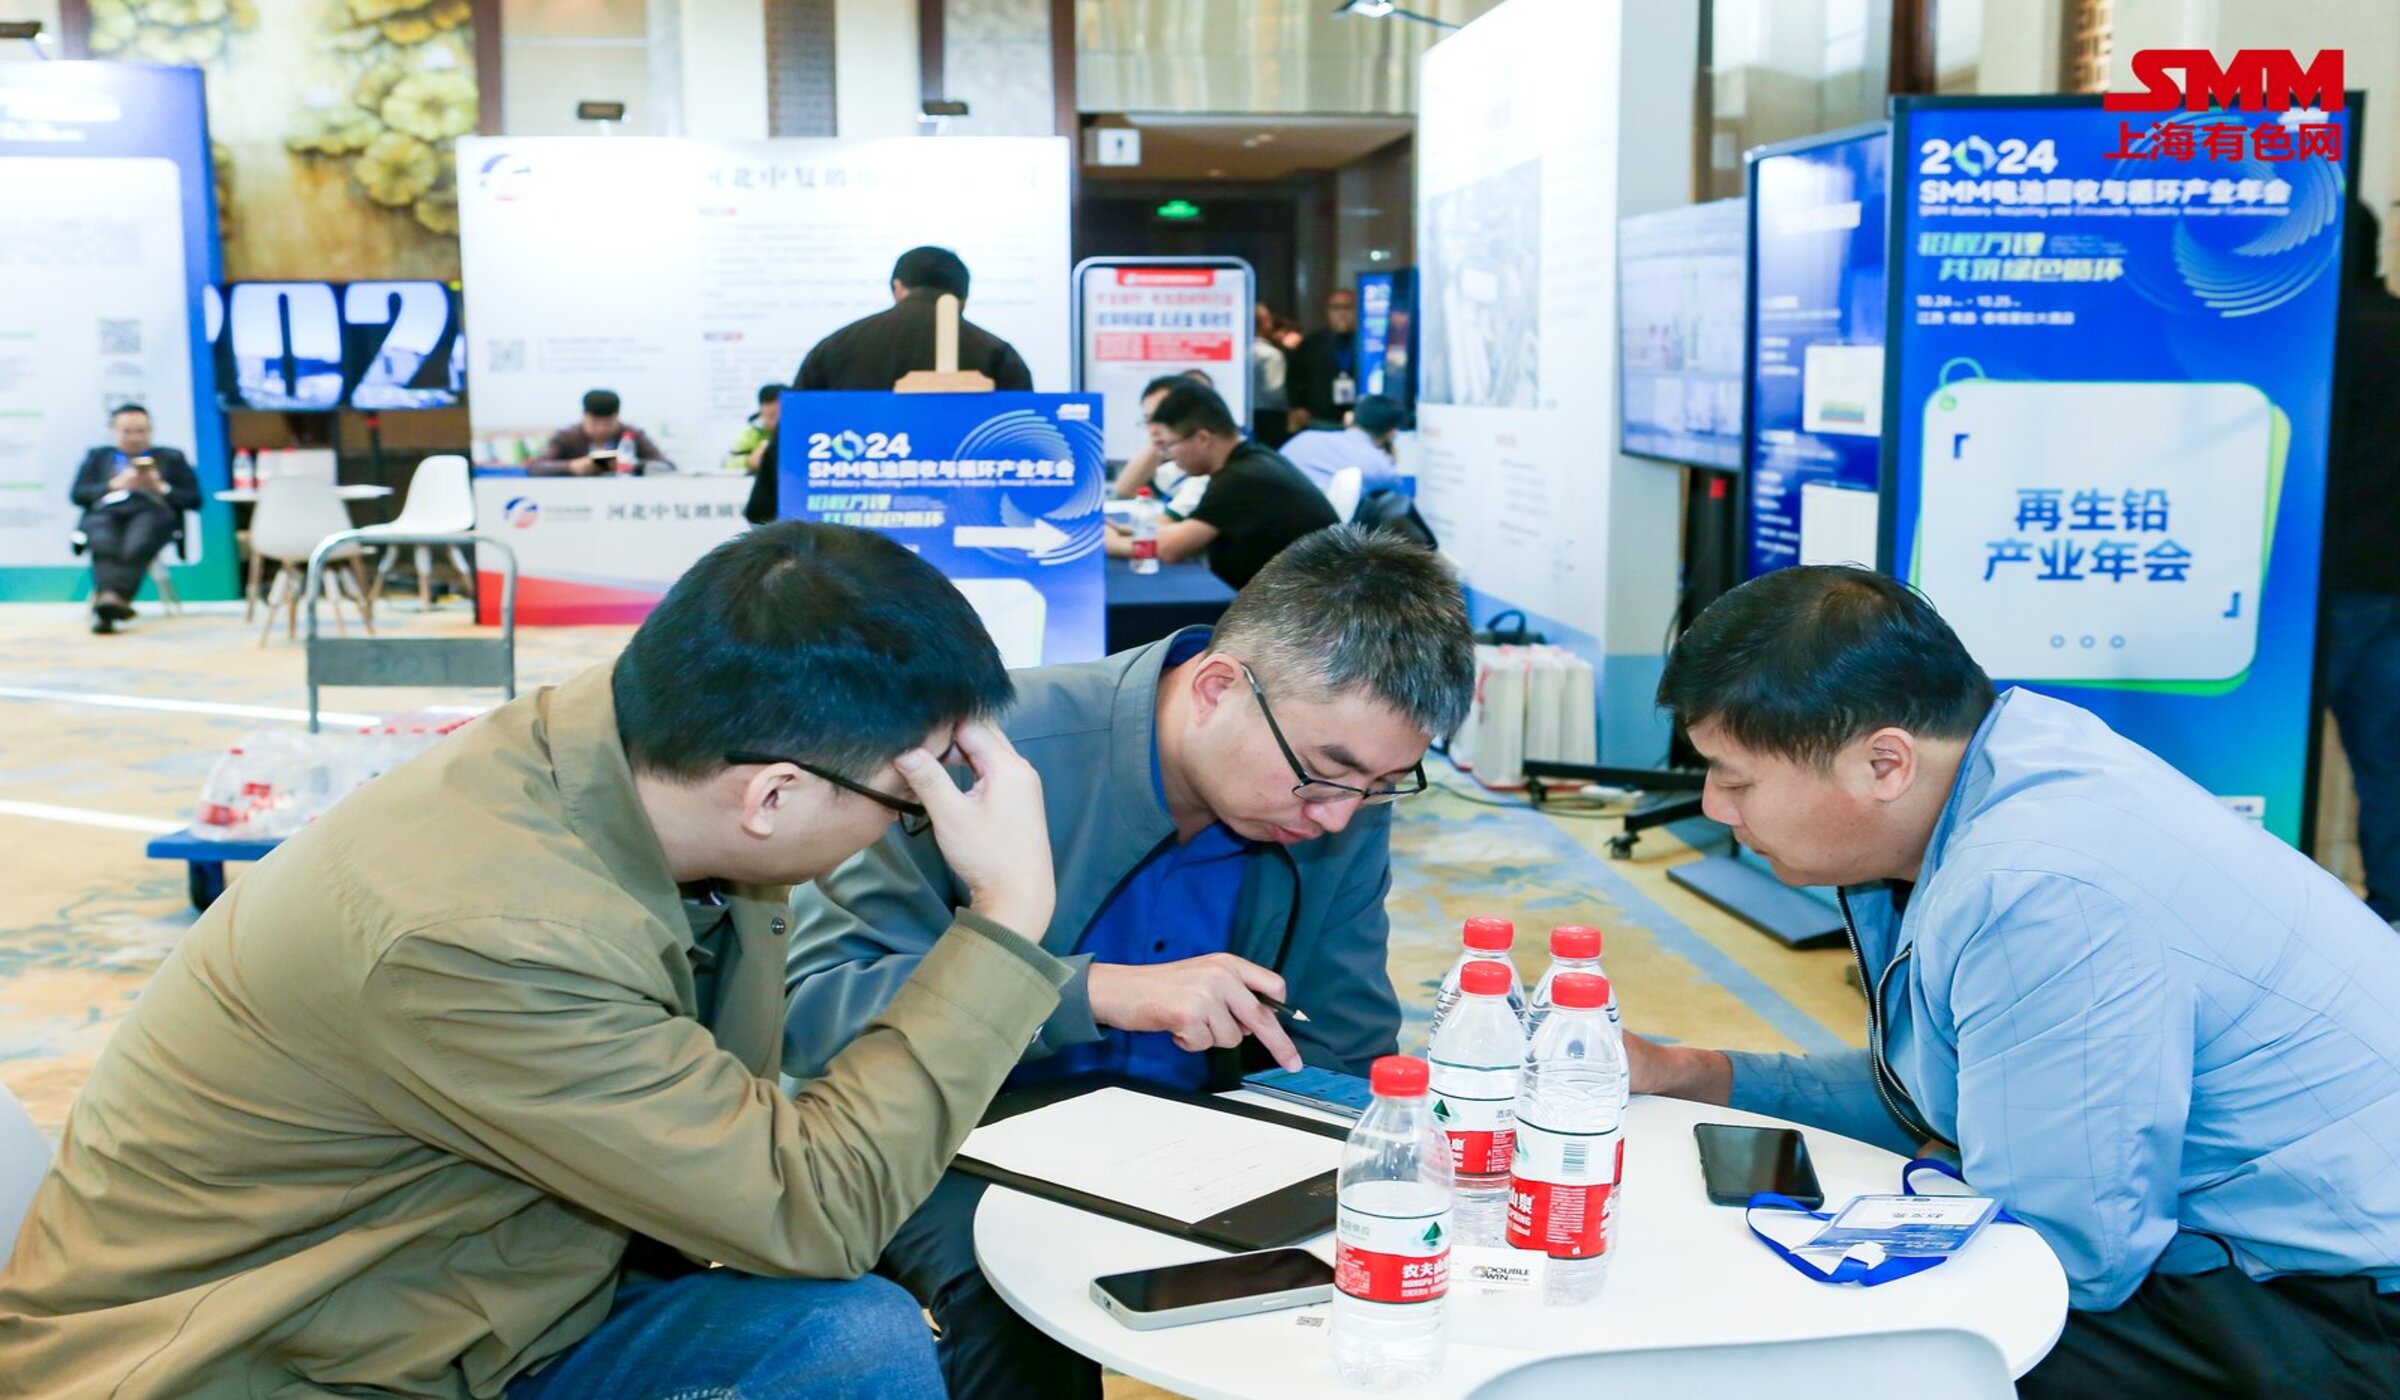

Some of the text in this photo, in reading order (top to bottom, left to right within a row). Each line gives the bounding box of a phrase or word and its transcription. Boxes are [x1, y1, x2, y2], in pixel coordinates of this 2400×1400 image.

[1919, 179, 2293, 205] SMM电池回收与循环产业年会
[808, 460, 1075, 479] SMM电池回收与循环产业年会
[2015, 489, 2169, 532] 再生铅
[1983, 539, 2193, 583] 产业年会
[1450, 1138, 1465, 1151] 泉
[1402, 1257, 1450, 1279] 农夫山
